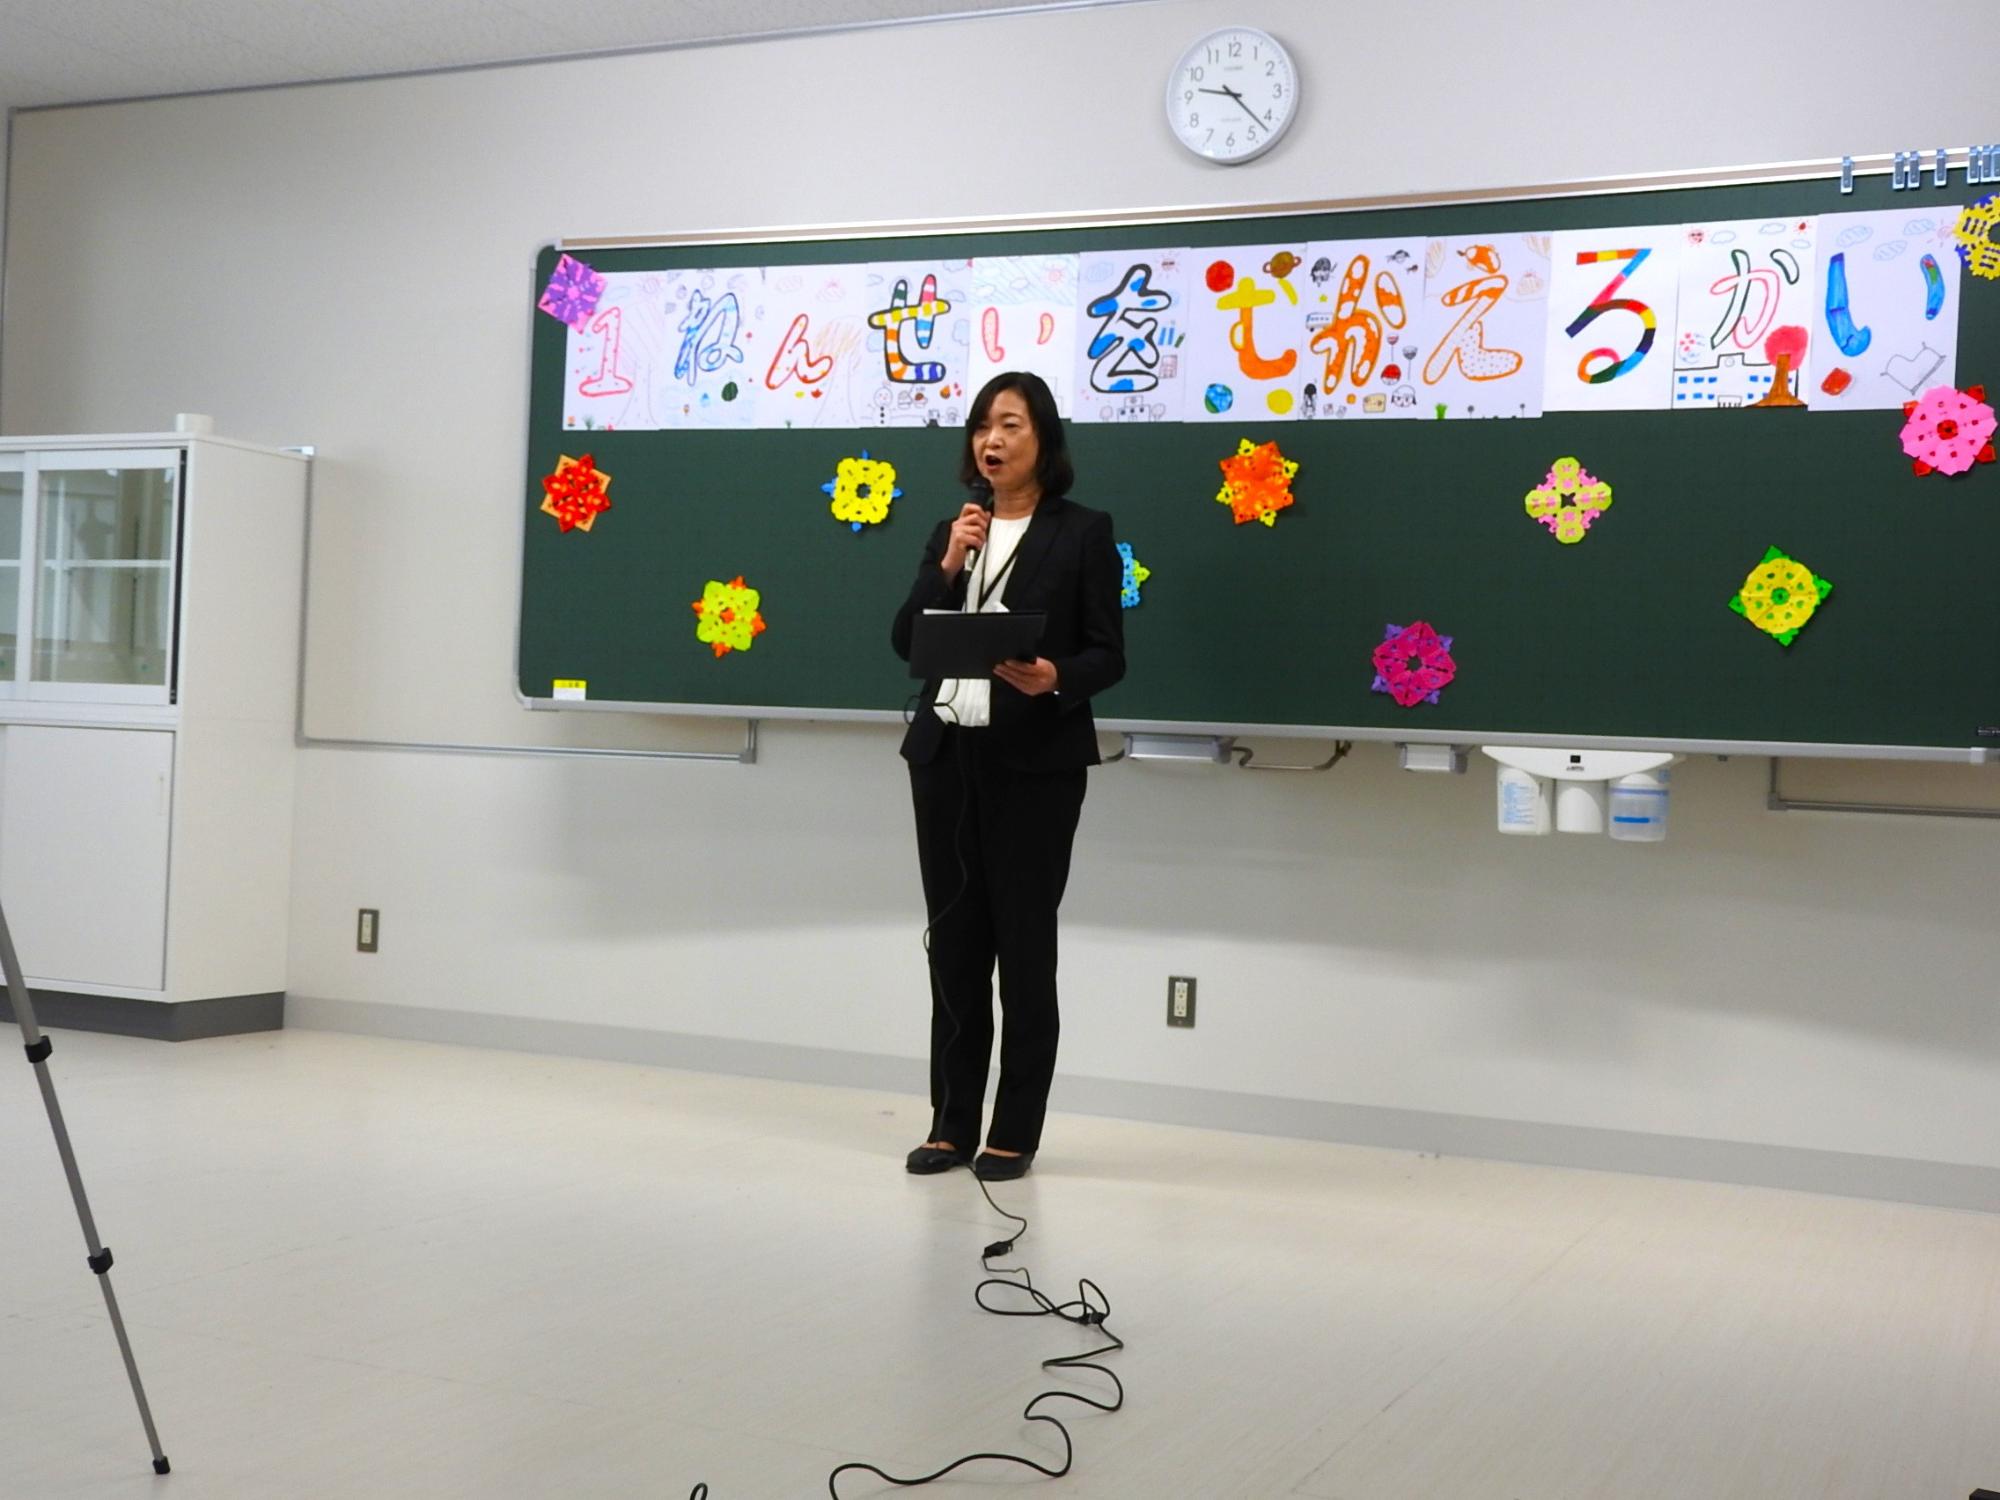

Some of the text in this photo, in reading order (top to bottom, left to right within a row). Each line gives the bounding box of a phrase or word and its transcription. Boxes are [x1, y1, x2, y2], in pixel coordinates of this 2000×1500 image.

[1206, 45, 1220, 64] 11
[1228, 41, 1242, 58] 12
[1253, 46, 1258, 61] 1
[1188, 66, 1204, 83] 10
[1265, 60, 1275, 77] 2
[1184, 89, 1194, 105] 9
[1272, 83, 1282, 99] 3
[1189, 112, 1199, 128] 8
[1264, 108, 1272, 121] 4
[1206, 128, 1214, 142] 7
[1226, 132, 1235, 147] 6
[1247, 125, 1256, 141] 5
